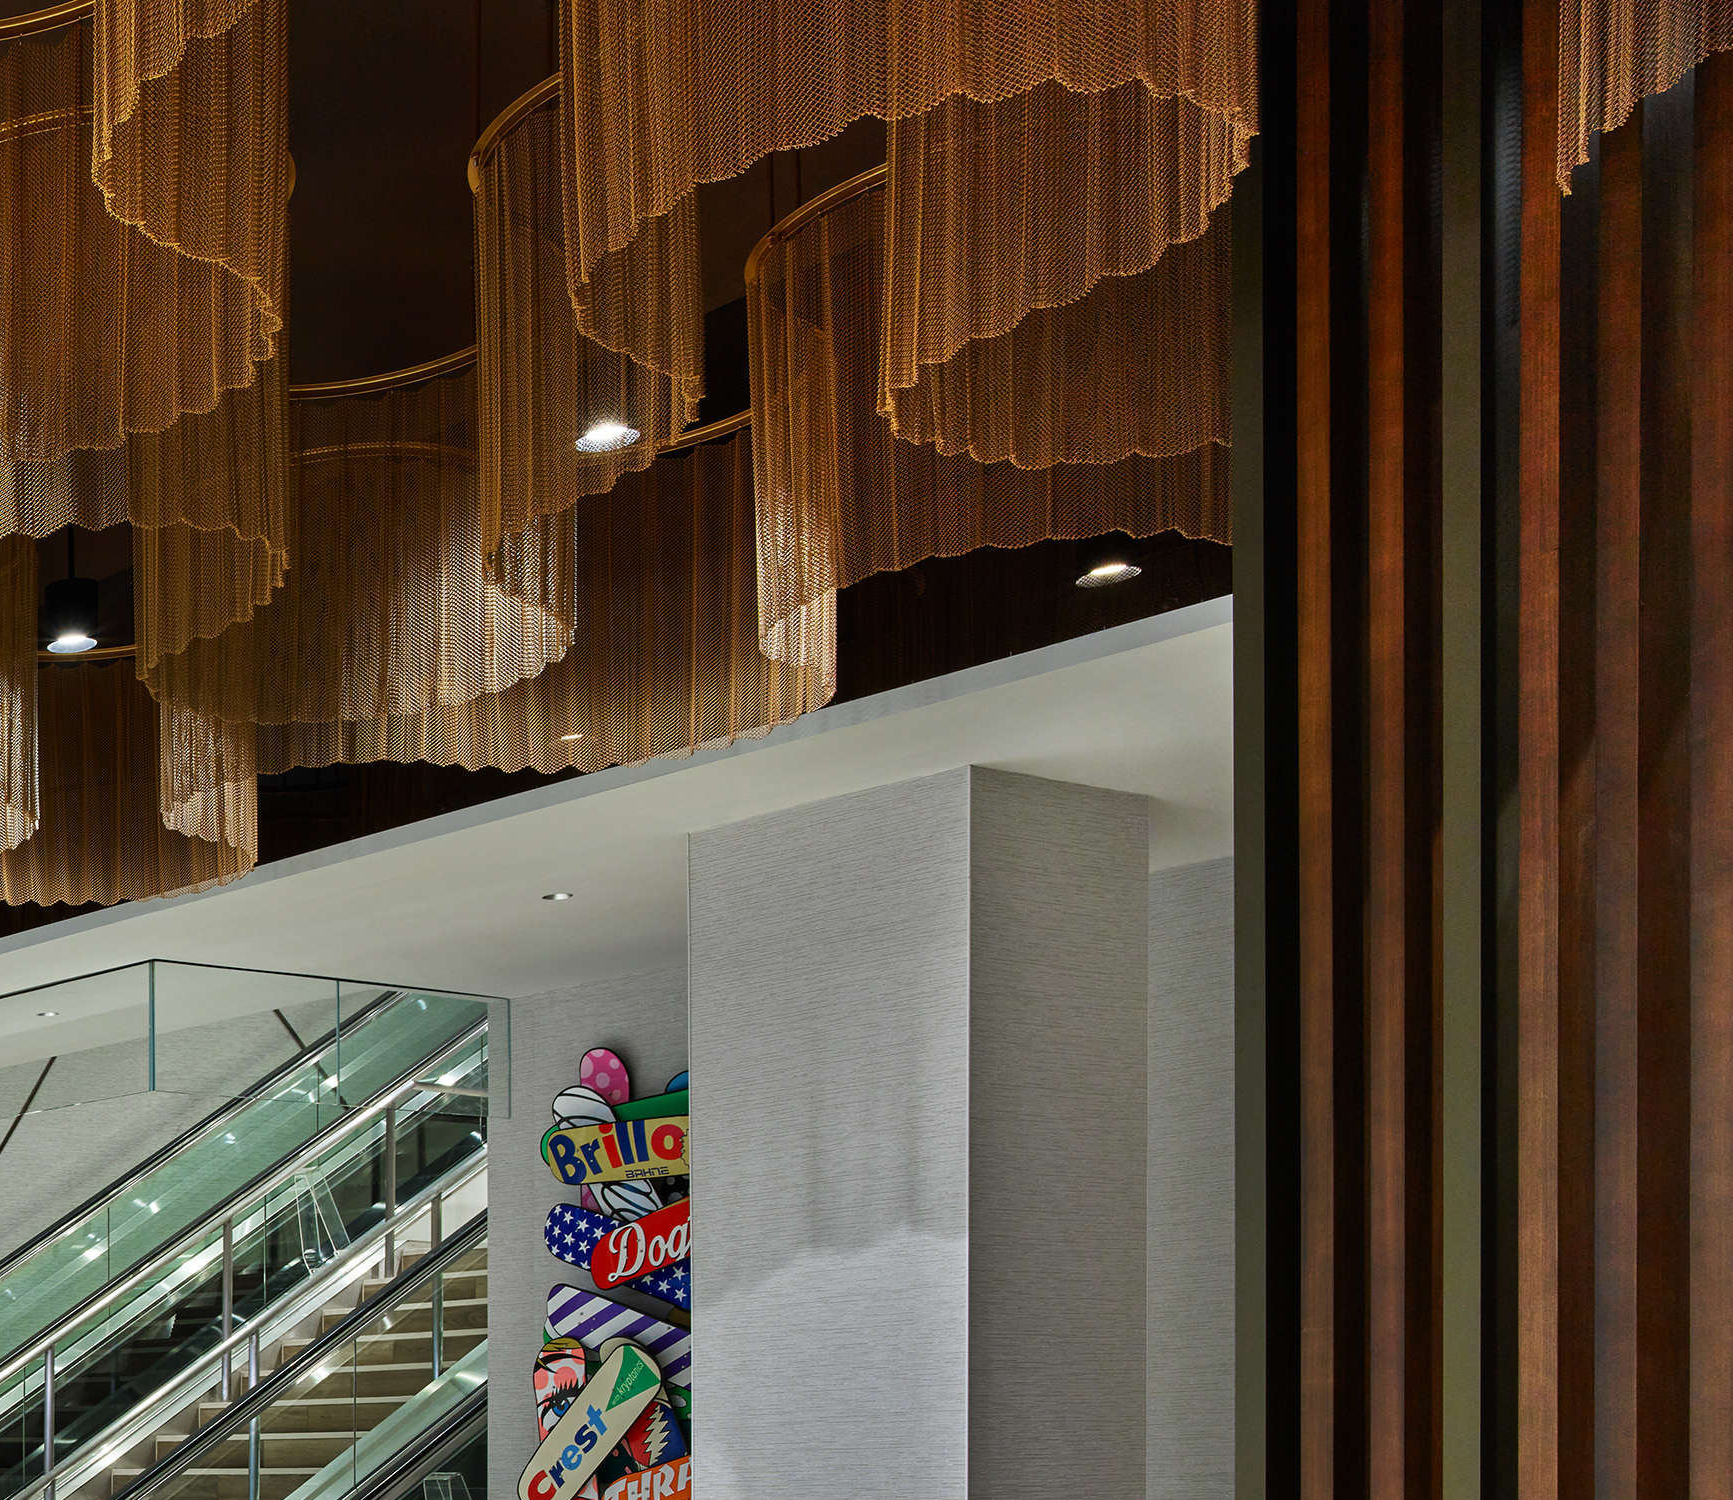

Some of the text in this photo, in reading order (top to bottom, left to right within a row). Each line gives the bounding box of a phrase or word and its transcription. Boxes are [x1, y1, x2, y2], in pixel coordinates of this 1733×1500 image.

[548, 1119, 685, 1184] Brillo
[625, 1166, 670, 1179] BAHNE
[617, 1360, 644, 1396] kryptonics
